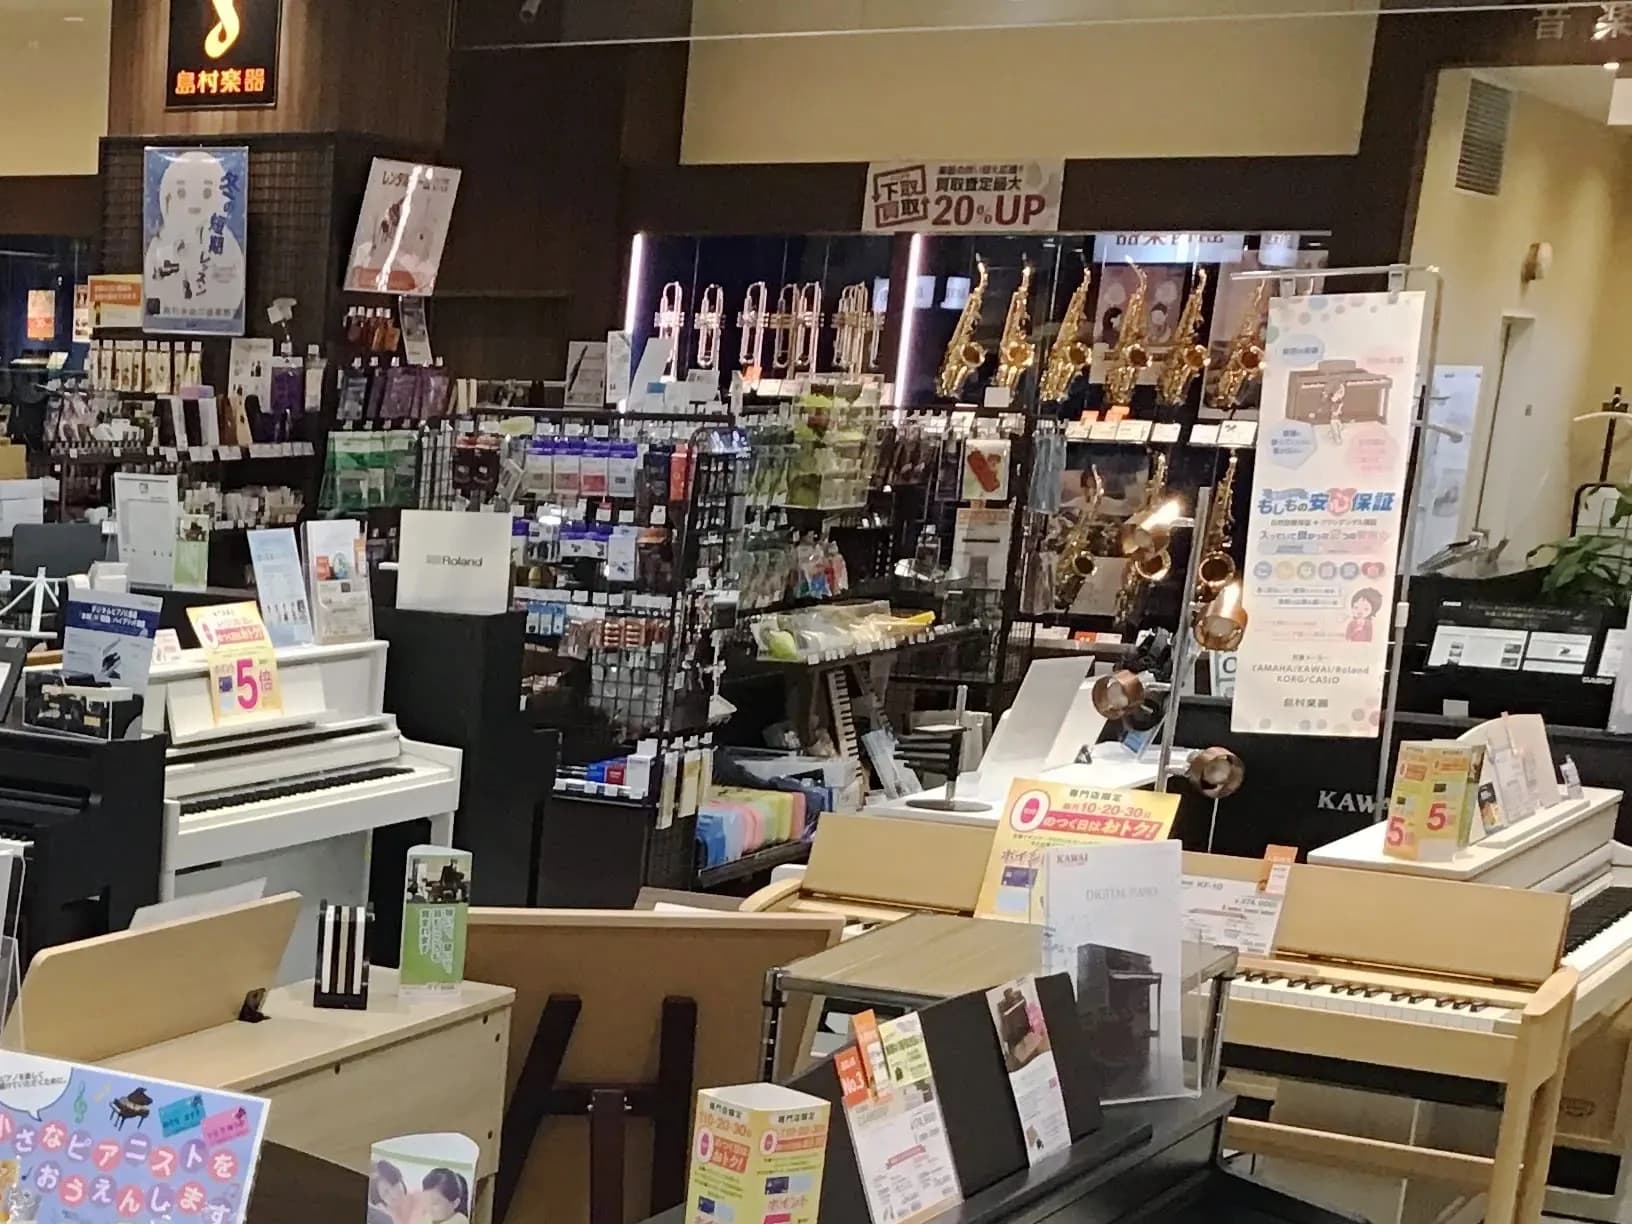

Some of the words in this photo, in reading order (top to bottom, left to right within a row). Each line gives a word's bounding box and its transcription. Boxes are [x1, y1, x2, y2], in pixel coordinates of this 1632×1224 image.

[175, 68, 266, 95] 島村楽器
[931, 194, 1046, 226] 20%UP
[442, 554, 484, 568] Roland
[236, 657, 259, 710] 5
[1386, 815, 1406, 847] 5
[1425, 802, 1447, 832] 5
[1056, 852, 1089, 865] KAWAI
[842, 1074, 866, 1098] No.3
